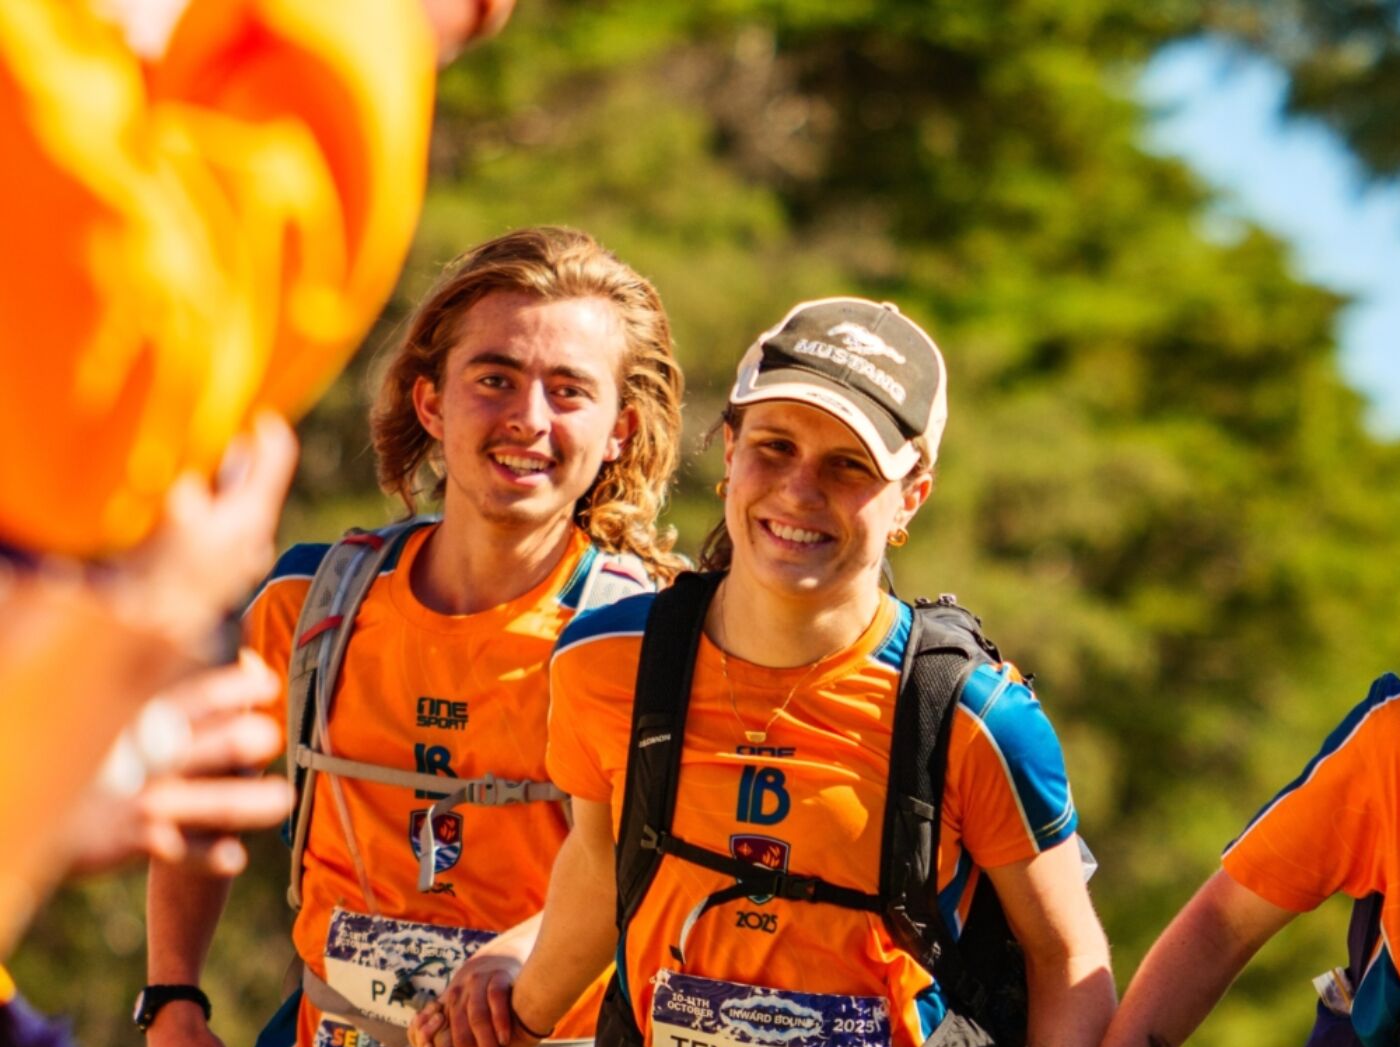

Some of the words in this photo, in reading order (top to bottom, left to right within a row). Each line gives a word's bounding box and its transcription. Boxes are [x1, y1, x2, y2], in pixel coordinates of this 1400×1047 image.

[794, 338, 907, 405] MUSTANG
[416, 716, 469, 730] SPORT
[736, 765, 791, 825] IB
[736, 911, 778, 934] 2025
[667, 1001, 714, 1019] OCTOBER
[729, 1008, 772, 1024] INWARD
[832, 1017, 875, 1034] 2025
